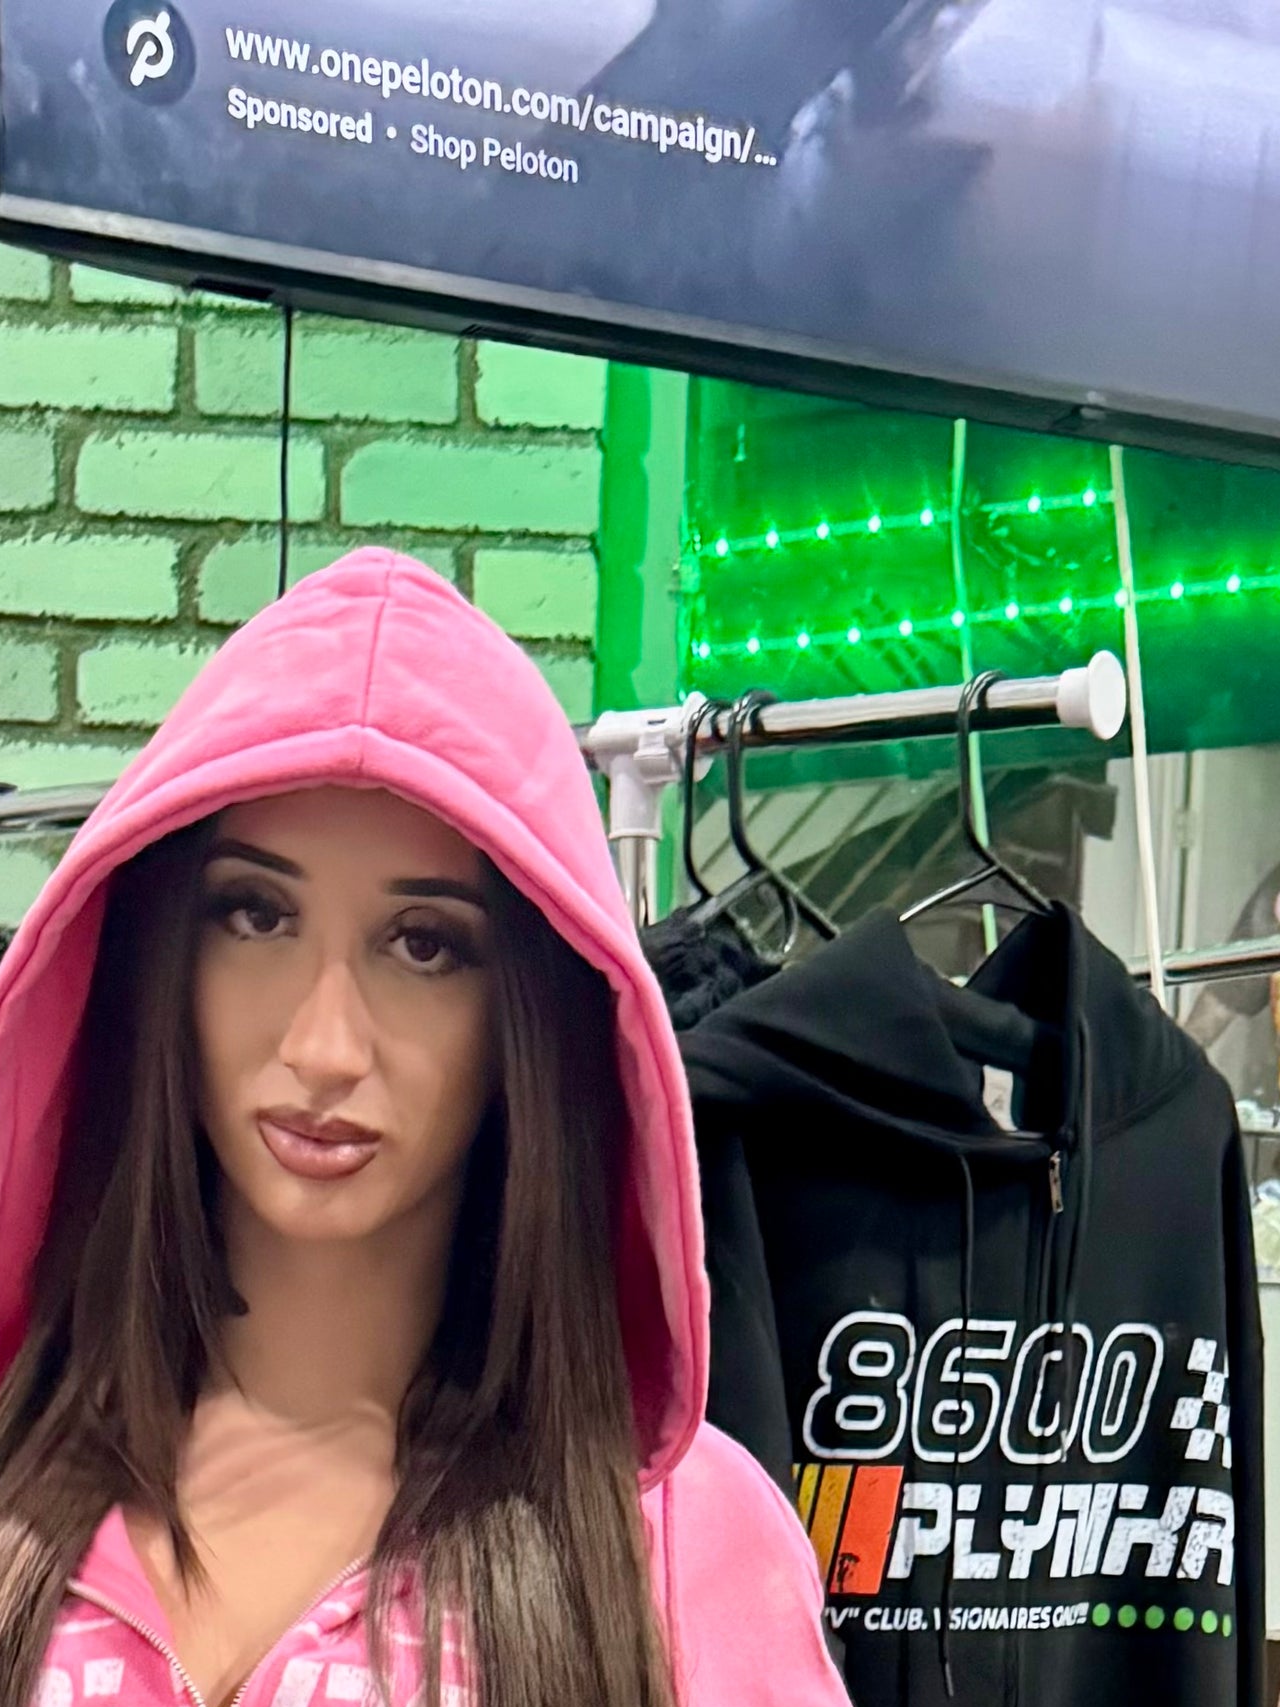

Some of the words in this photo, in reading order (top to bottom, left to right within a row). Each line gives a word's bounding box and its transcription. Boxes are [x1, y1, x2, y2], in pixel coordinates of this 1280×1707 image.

[225, 27, 779, 167] www.onepeloton.com/campaign/...
[228, 86, 373, 144] Sponsored
[410, 122, 477, 163] Shop
[483, 137, 579, 184] Peloton
[802, 1310, 1165, 1465] 8600
[864, 1606, 928, 1631] CLUB.
